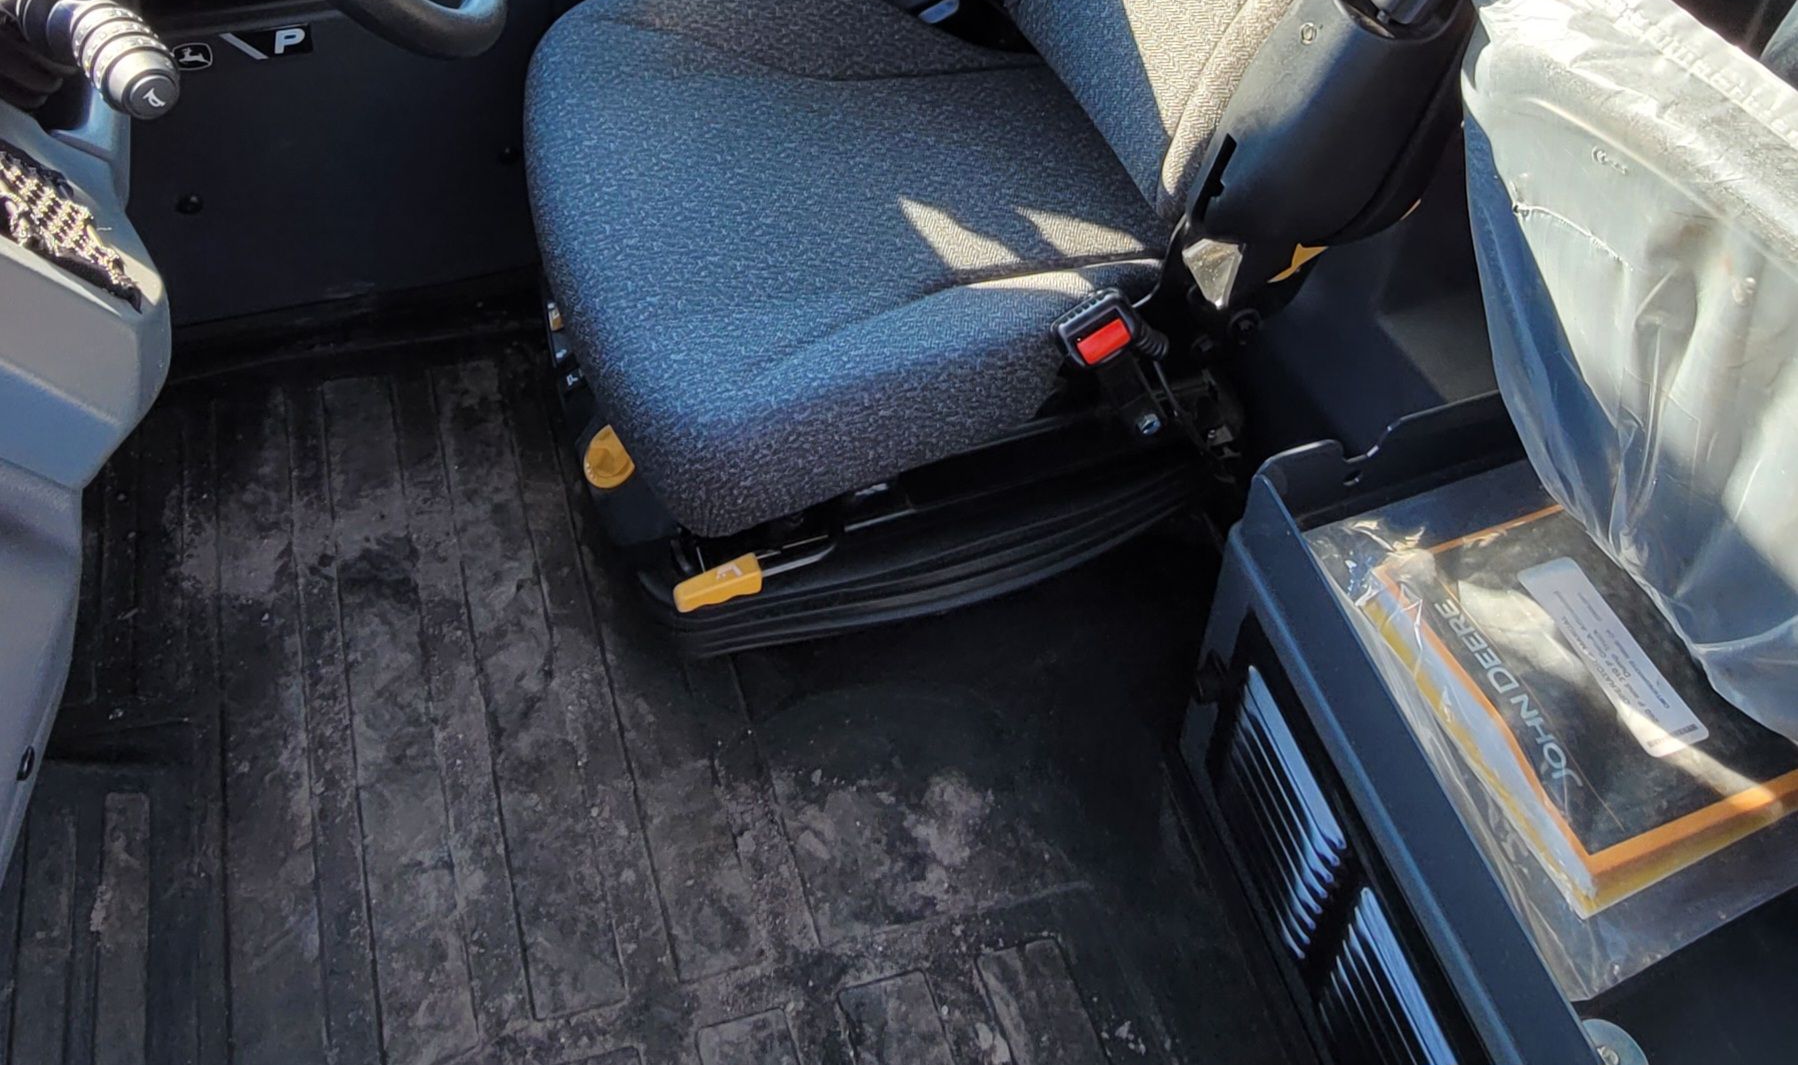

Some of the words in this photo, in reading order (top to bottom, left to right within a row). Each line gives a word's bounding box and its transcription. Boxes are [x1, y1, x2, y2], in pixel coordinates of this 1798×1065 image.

[274, 28, 306, 55] P
[1434, 598, 1519, 694] DEERE
[1609, 651, 1631, 678] Dump
[1509, 693, 1583, 787] JOHN
